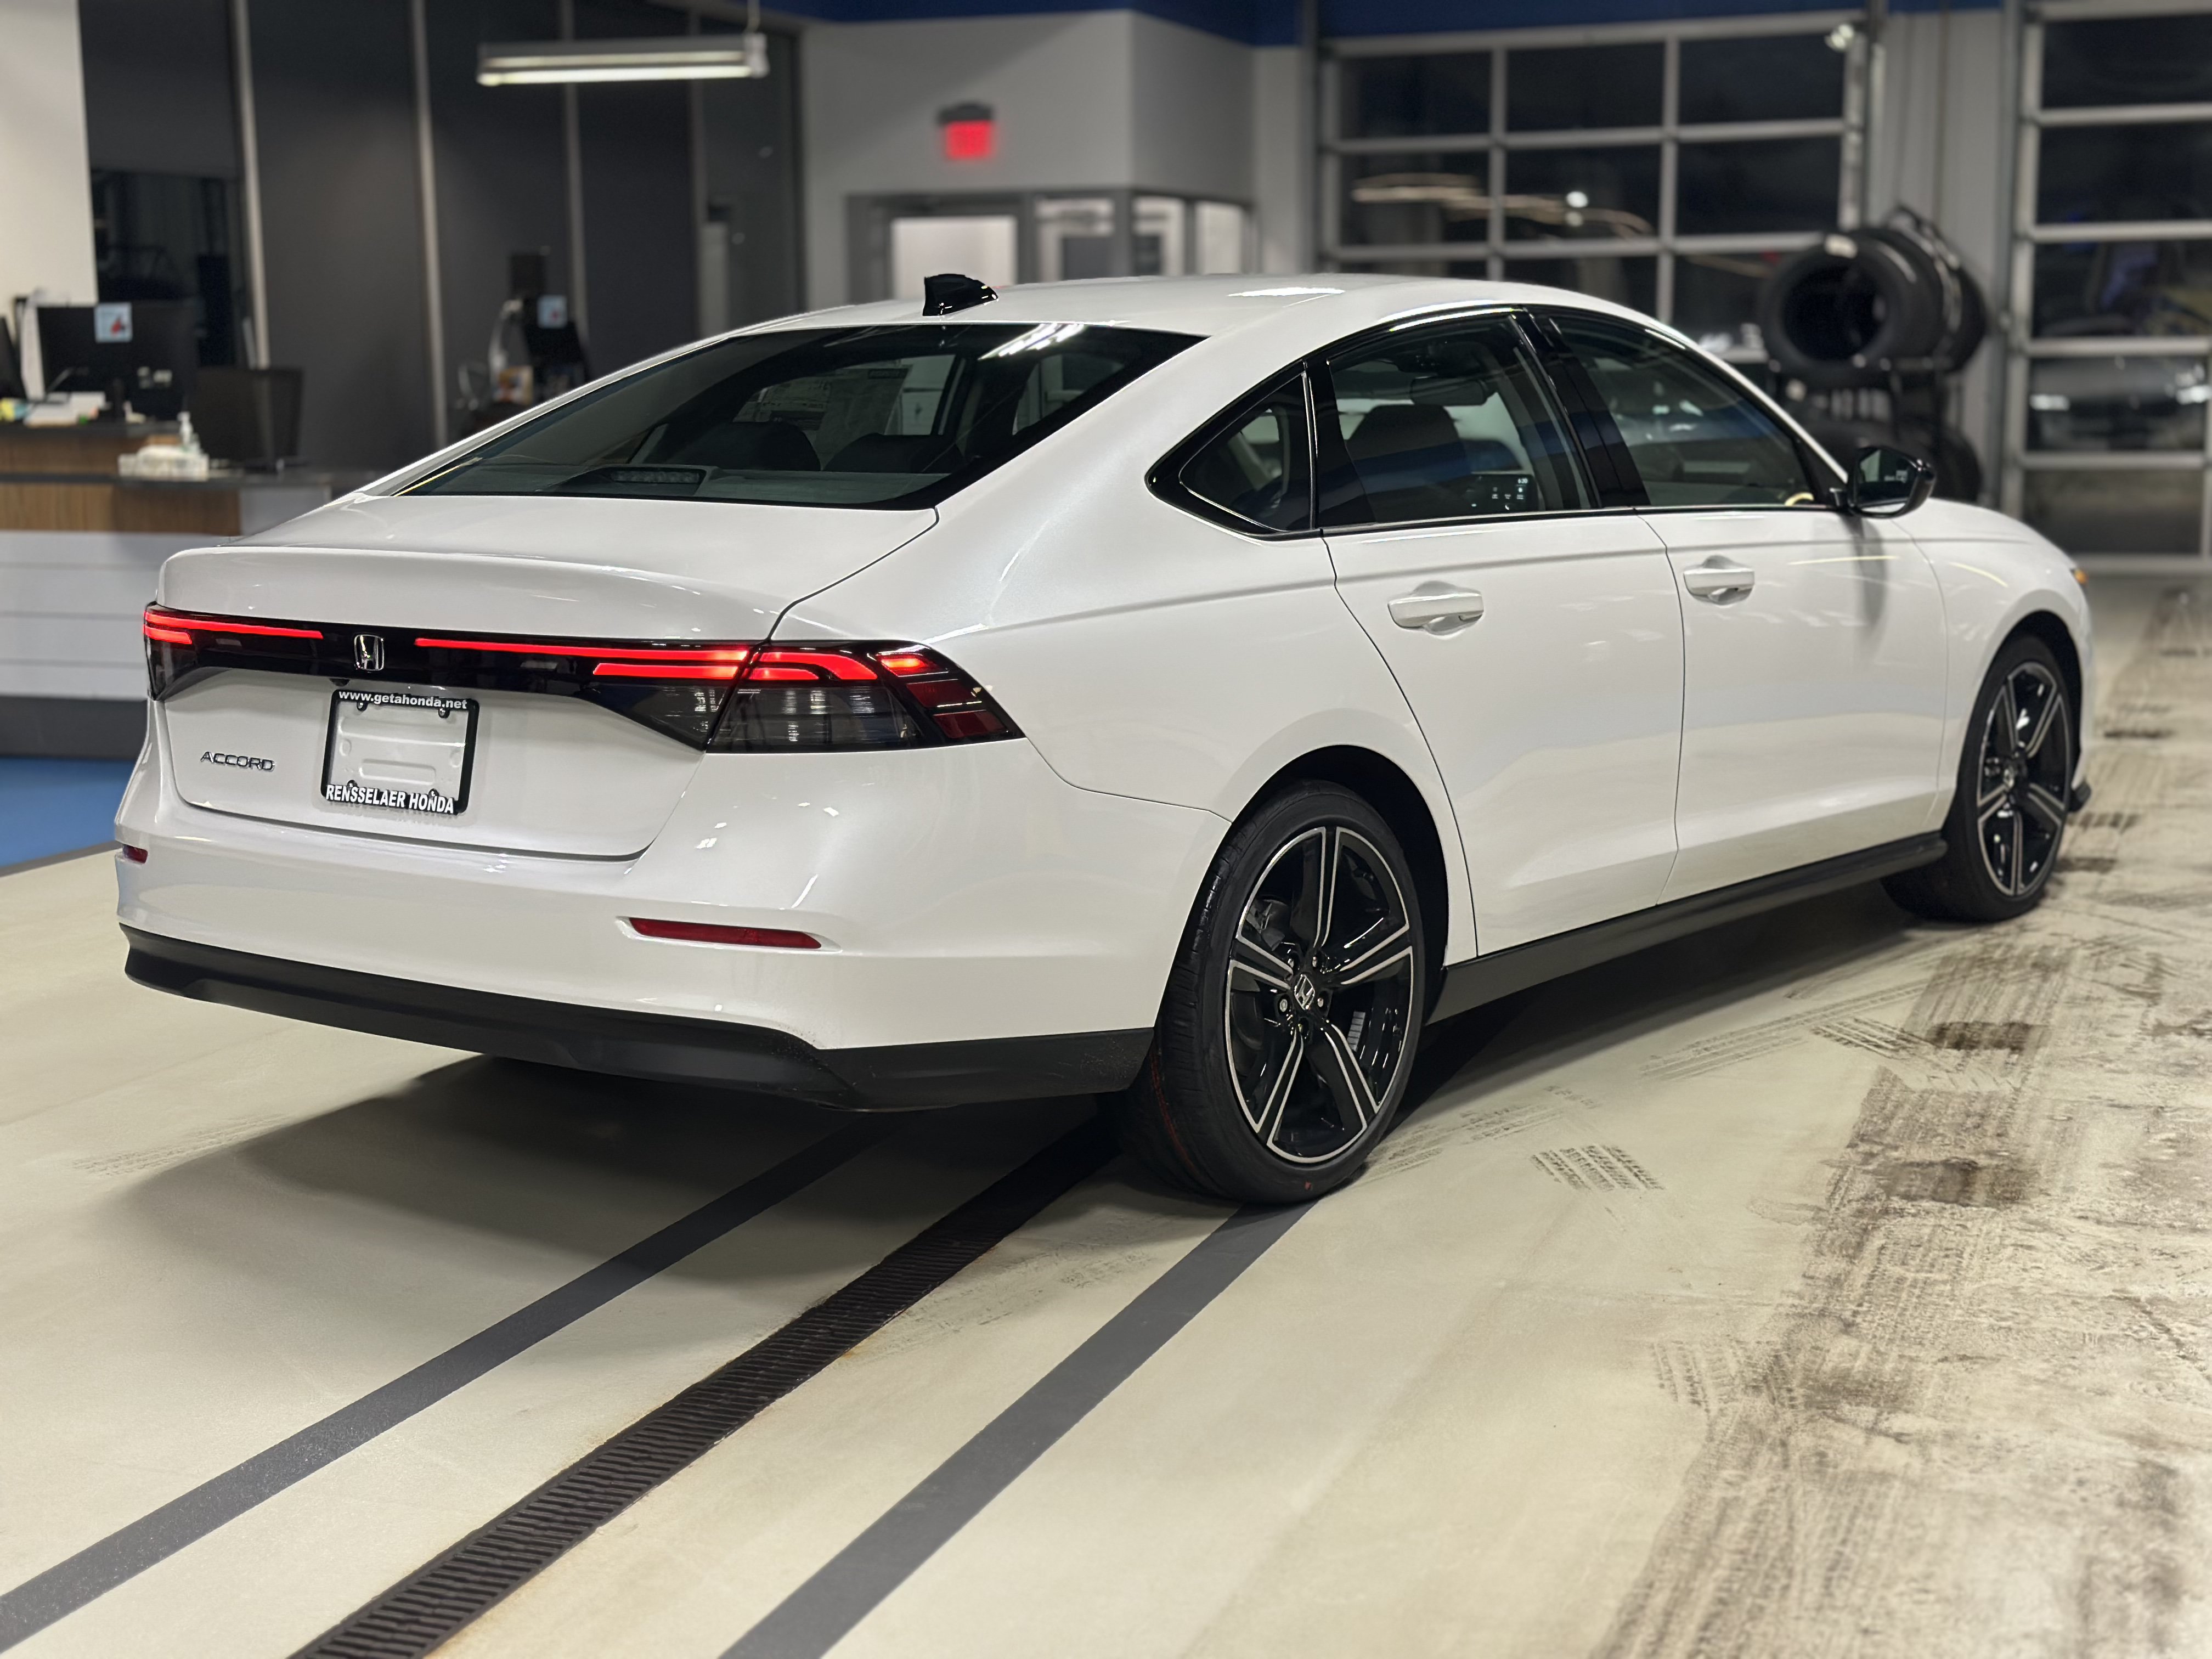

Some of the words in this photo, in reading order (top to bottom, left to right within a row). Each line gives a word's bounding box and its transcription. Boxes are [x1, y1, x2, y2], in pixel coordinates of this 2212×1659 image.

[338, 691, 467, 709] www.getahonda.net
[200, 751, 275, 772] ACCORD
[326, 784, 406, 808] RENSSELAER
[409, 792, 454, 814] HONDA
